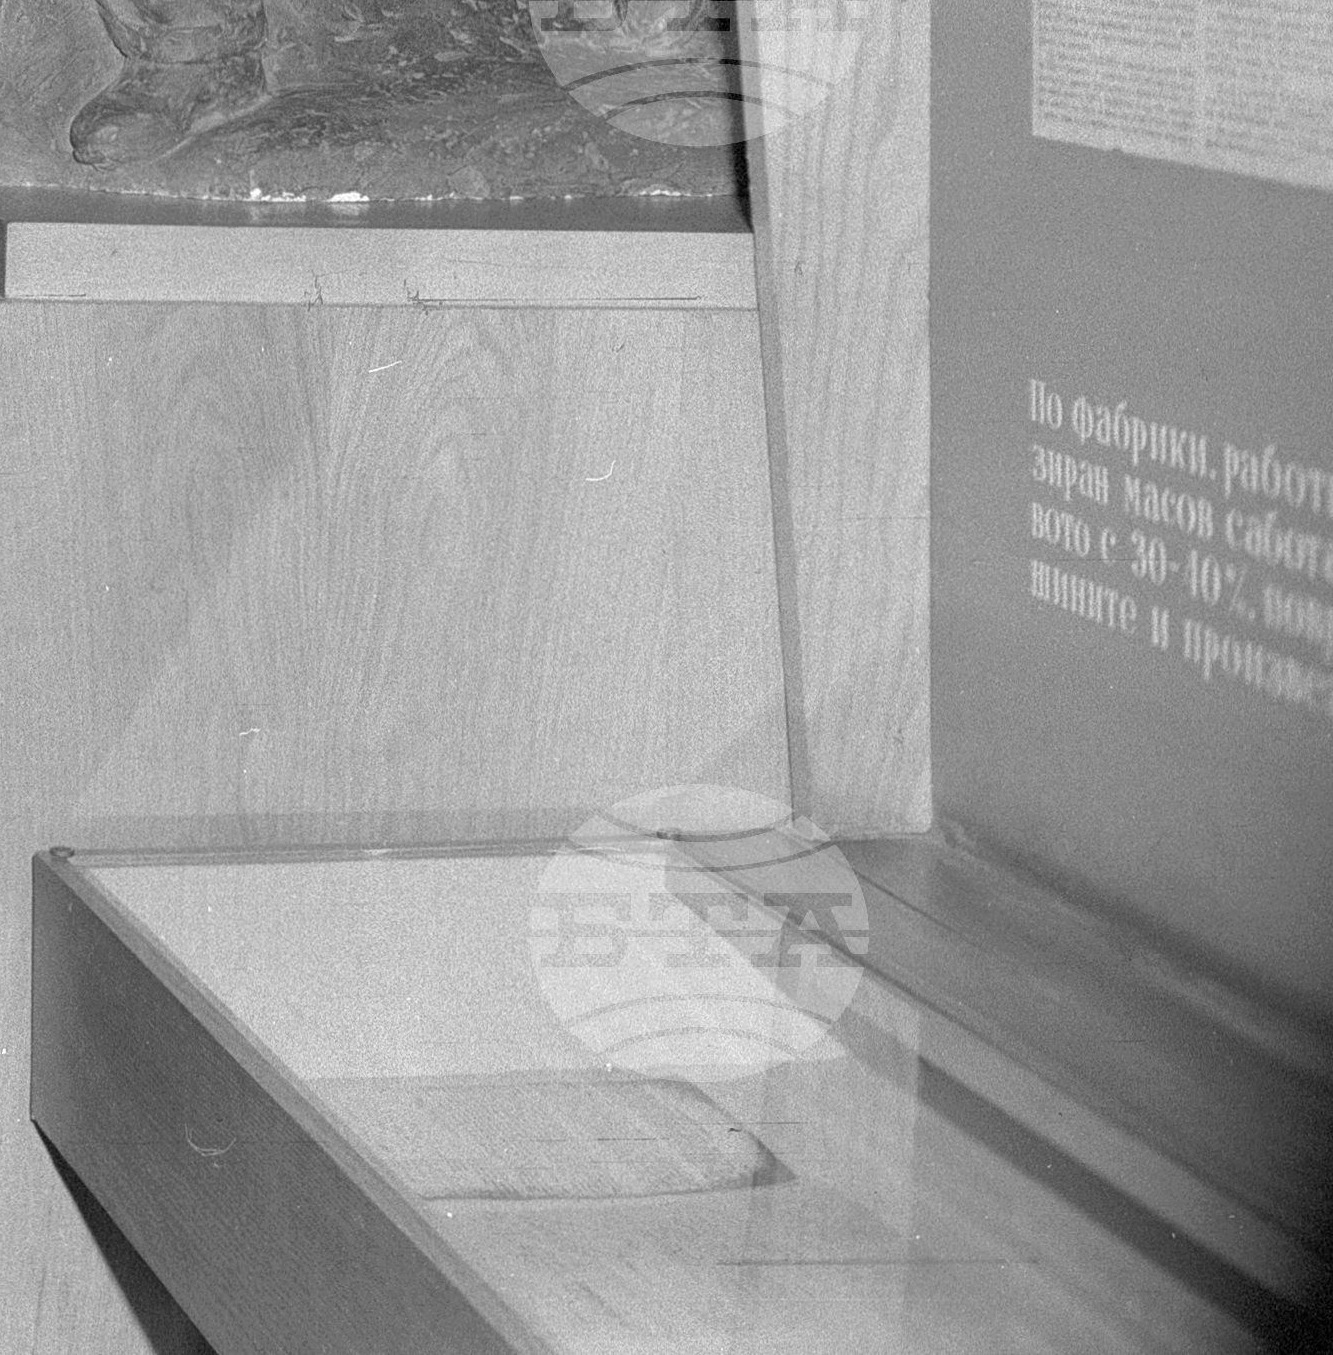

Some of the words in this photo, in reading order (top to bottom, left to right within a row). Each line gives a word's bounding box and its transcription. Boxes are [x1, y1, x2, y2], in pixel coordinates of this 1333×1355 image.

[1032, 379, 1062, 429] По
[1032, 445, 1109, 503] зиран
[1125, 474, 1213, 542] масов
[1032, 502, 1090, 557] вото
[1101, 527, 1116, 563] с
[1031, 560, 1137, 634] шините
[1151, 606, 1170, 650] и
